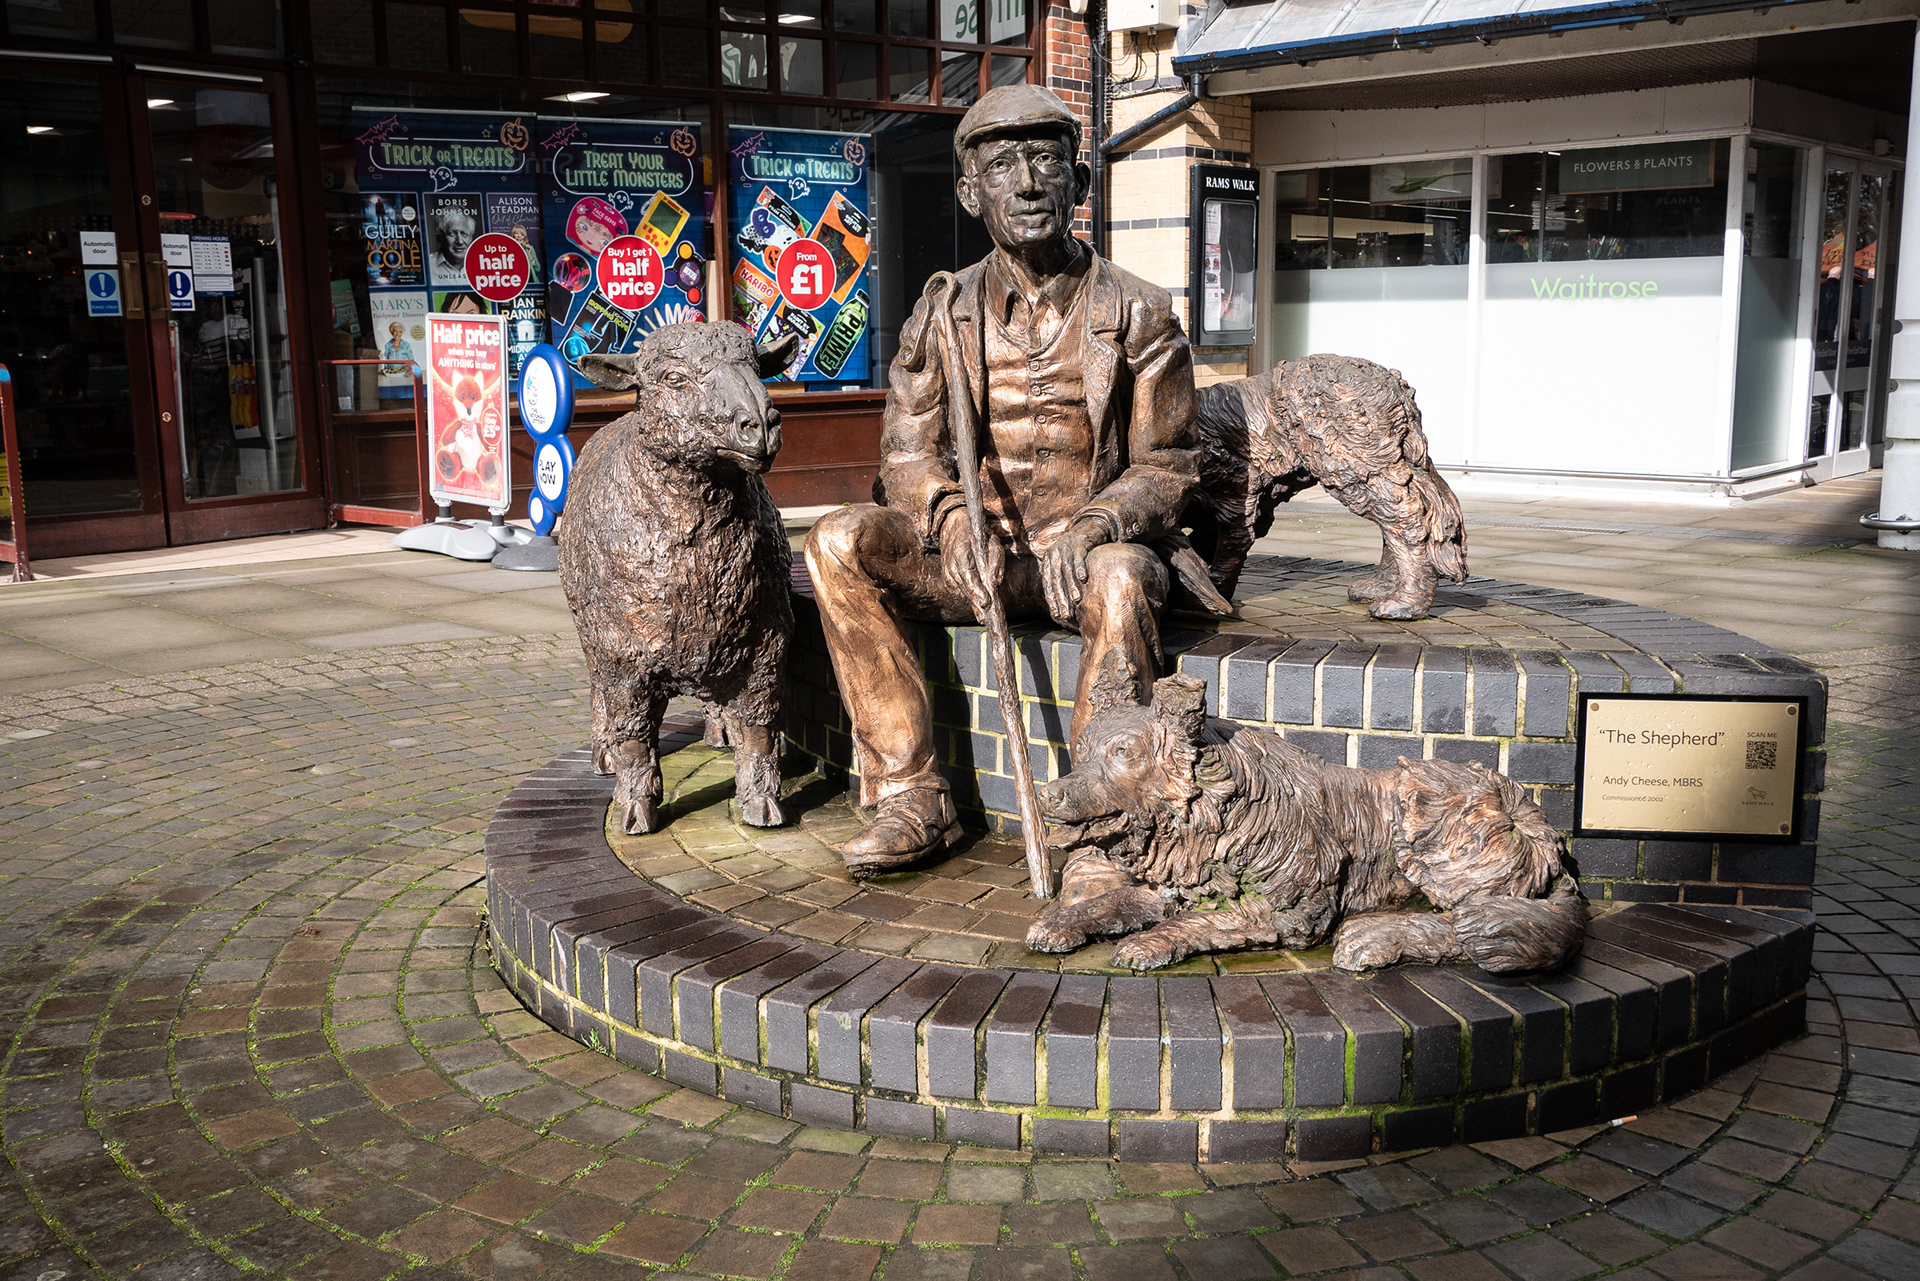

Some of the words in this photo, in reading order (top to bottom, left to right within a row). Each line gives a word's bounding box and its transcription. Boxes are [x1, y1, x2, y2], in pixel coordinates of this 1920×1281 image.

[380, 143, 434, 166] TRICK
[437, 150, 450, 162] OR
[450, 144, 516, 167] TREATS
[583, 150, 624, 168] TREAT
[628, 152, 664, 170] YOUR
[751, 155, 792, 176] TRICK
[794, 163, 806, 174] OR
[806, 158, 854, 180] TREATS
[1574, 160, 1630, 173] FLOWERS
[1644, 156, 1693, 168] PLANTS
[566, 168, 609, 187] LITTLE
[613, 169, 684, 189] MONSTERS
[1206, 177, 1230, 190] RAMS
[1232, 178, 1255, 192] WALK
[490, 206, 539, 214] STEADMAN
[365, 225, 417, 239] GUILTY
[366, 239, 419, 250] MARTINA
[484, 245, 497, 253] Up
[368, 250, 421, 268] COLE
[608, 248, 624, 258] Buy
[632, 248, 646, 257] get
[796, 252, 817, 261] From
[479, 254, 515, 270] half
[612, 258, 649, 276] half
[475, 271, 521, 291] price
[740, 268, 774, 298] HARIBO
[790, 264, 823, 294] £1
[1531, 273, 1659, 301] Waitrose
[608, 278, 655, 299] price
[372, 299, 424, 311] MARY'S
[513, 298, 534, 308] IAN
[501, 309, 546, 320] RANKIN
[433, 324, 463, 344] Half
[465, 324, 500, 348] price
[820, 314, 861, 369] PRIME
[476, 349, 487, 359] buy
[438, 358, 474, 368] ANYTHING
[539, 460, 556, 472] PLAY
[1599, 730, 1636, 744] “The
[1642, 731, 1725, 748] Shepherd”
[1603, 776, 1629, 788] Andy
[1632, 776, 1670, 787] Cheese,
[1673, 778, 1703, 787] MBRS
